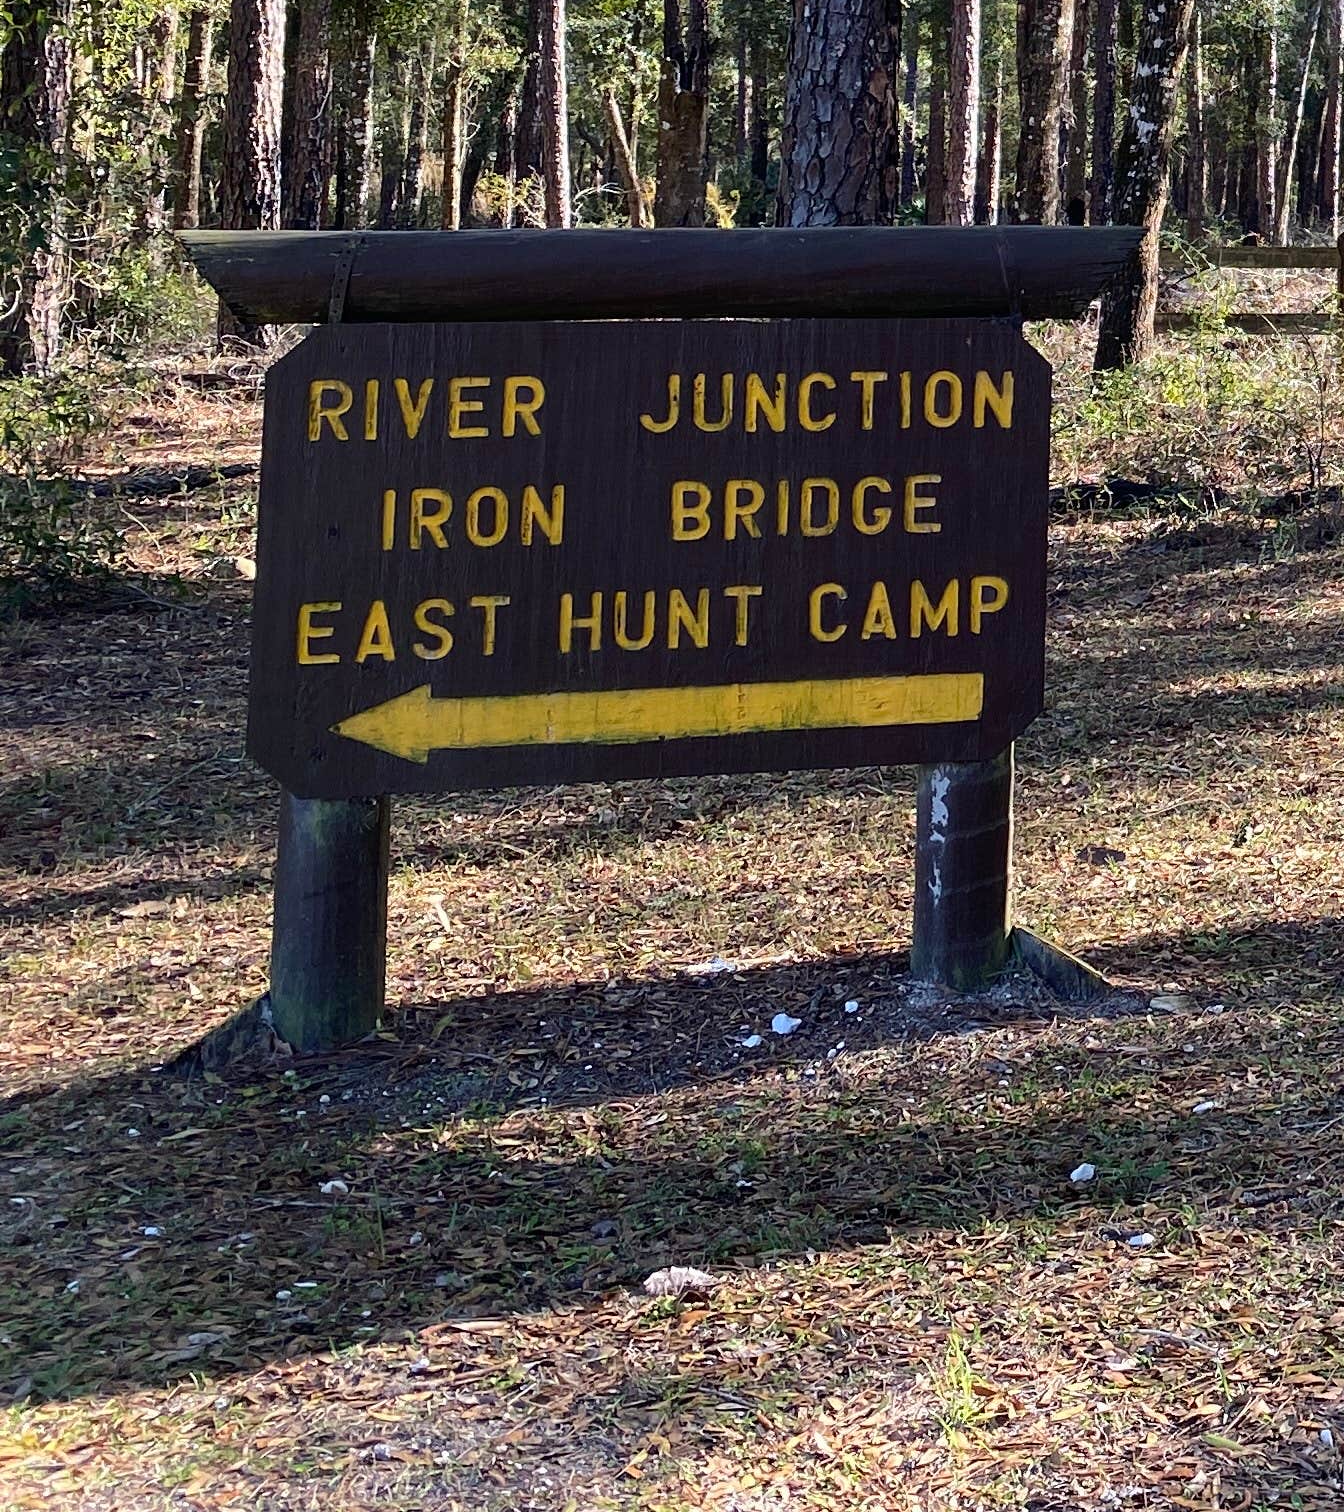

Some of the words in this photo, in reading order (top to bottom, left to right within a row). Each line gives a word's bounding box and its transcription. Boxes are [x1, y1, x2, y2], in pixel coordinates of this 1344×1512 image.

[308, 374, 547, 442] RIVER
[639, 369, 1015, 434] JUNCTION
[382, 484, 565, 551] IRON
[671, 473, 943, 542] BRIDGE
[297, 595, 511, 666] EAST
[559, 585, 764, 655] HUNT
[809, 575, 1010, 643] CAMP
